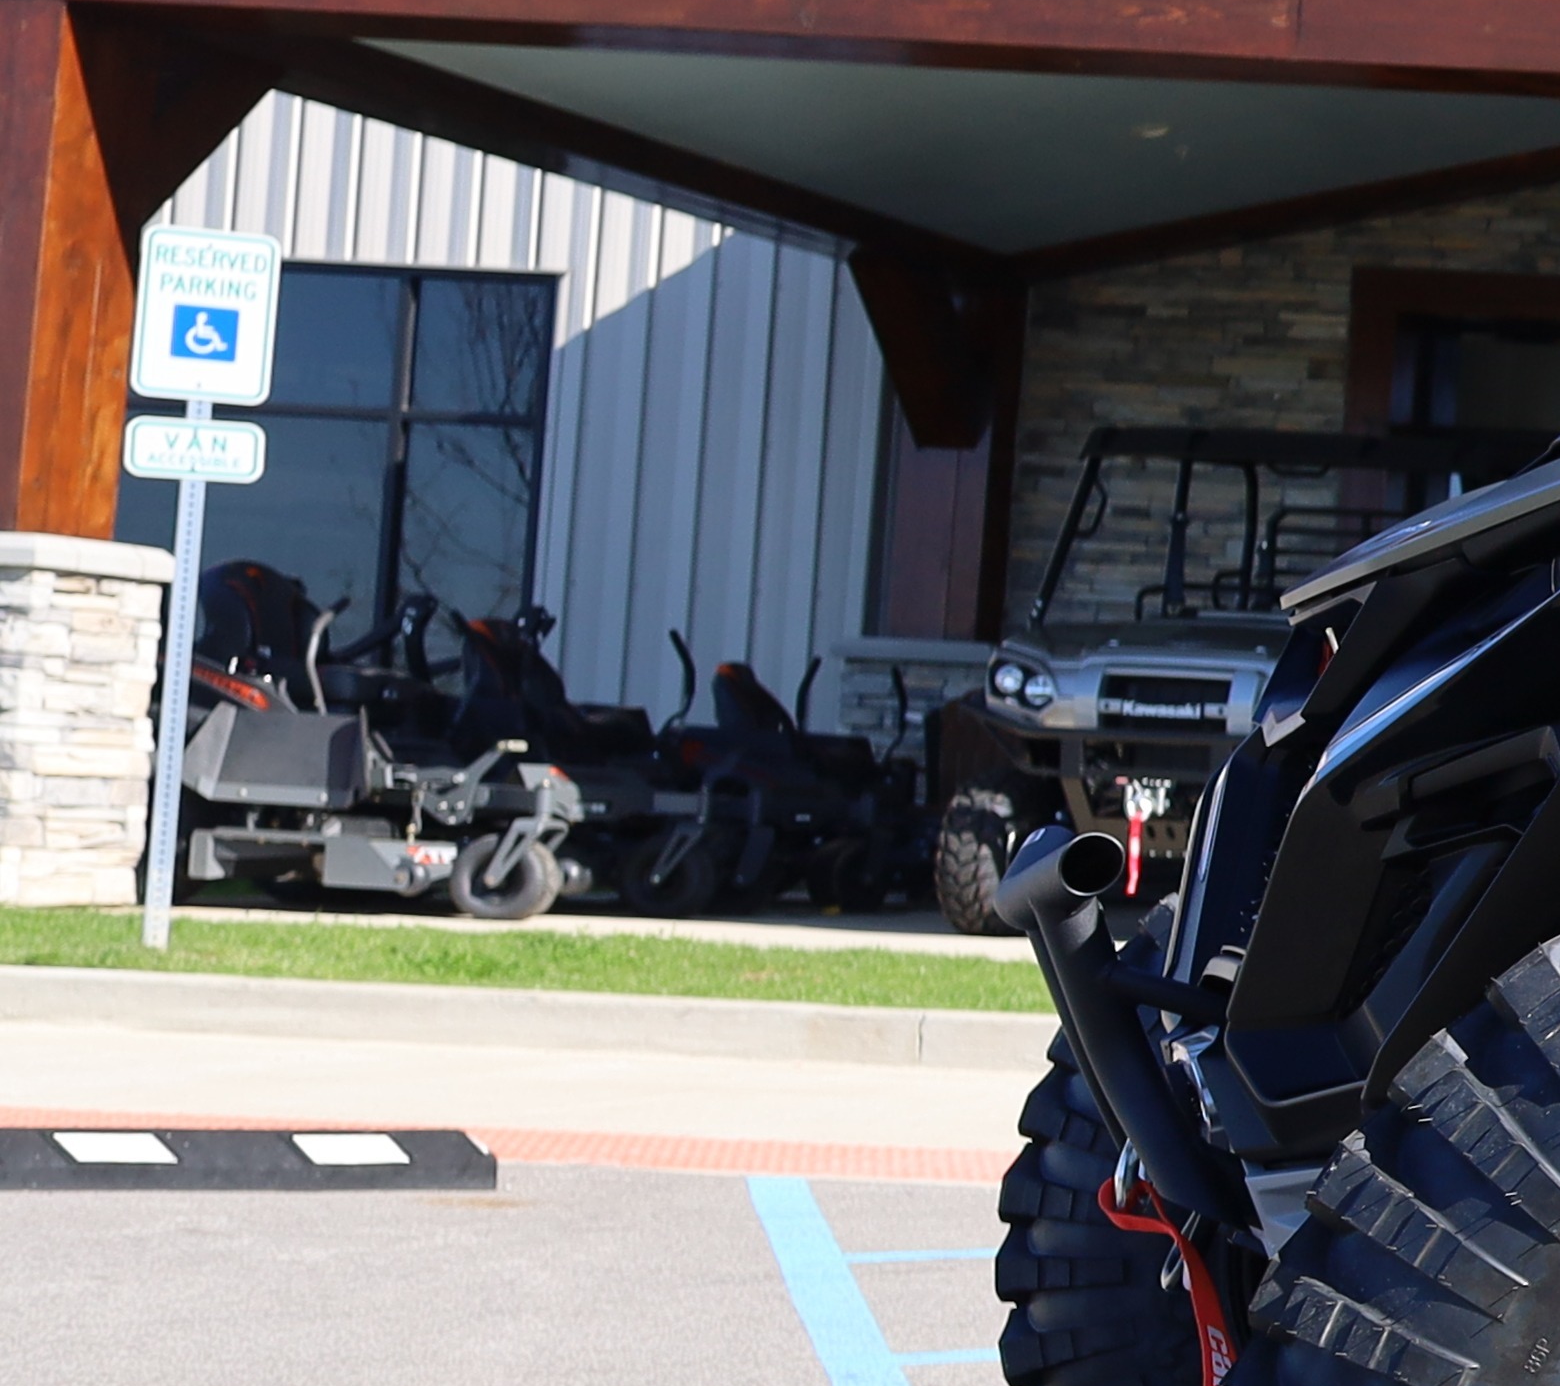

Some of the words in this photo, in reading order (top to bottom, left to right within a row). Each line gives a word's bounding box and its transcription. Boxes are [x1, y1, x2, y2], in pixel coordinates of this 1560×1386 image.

[155, 243, 268, 274] RESERVED
[159, 272, 258, 301] PARKING
[165, 431, 228, 454] VAN
[1122, 699, 1202, 720] Kawasaki
